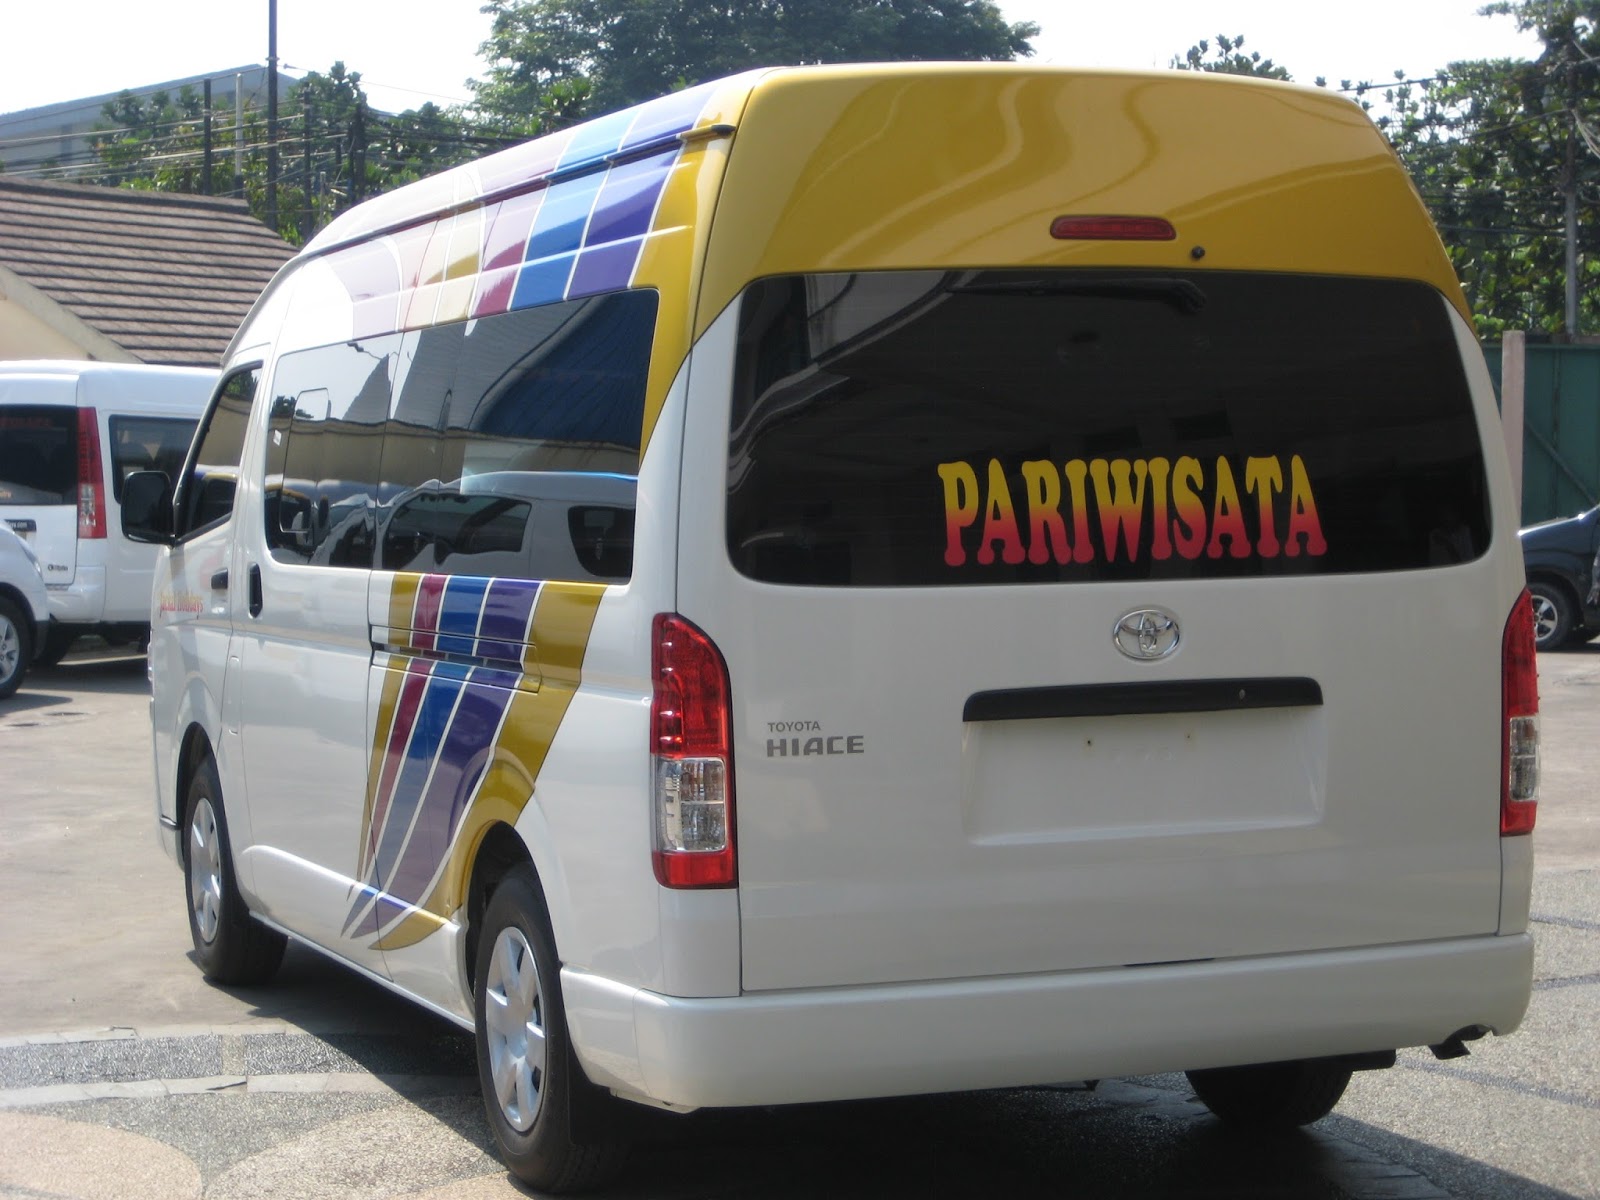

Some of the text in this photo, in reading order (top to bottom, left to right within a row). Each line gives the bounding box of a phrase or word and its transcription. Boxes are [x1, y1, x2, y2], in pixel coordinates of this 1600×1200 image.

[938, 455, 1327, 566] PARIWISATA
[767, 720, 821, 733] TOYOTA
[766, 735, 865, 757] HIACE
